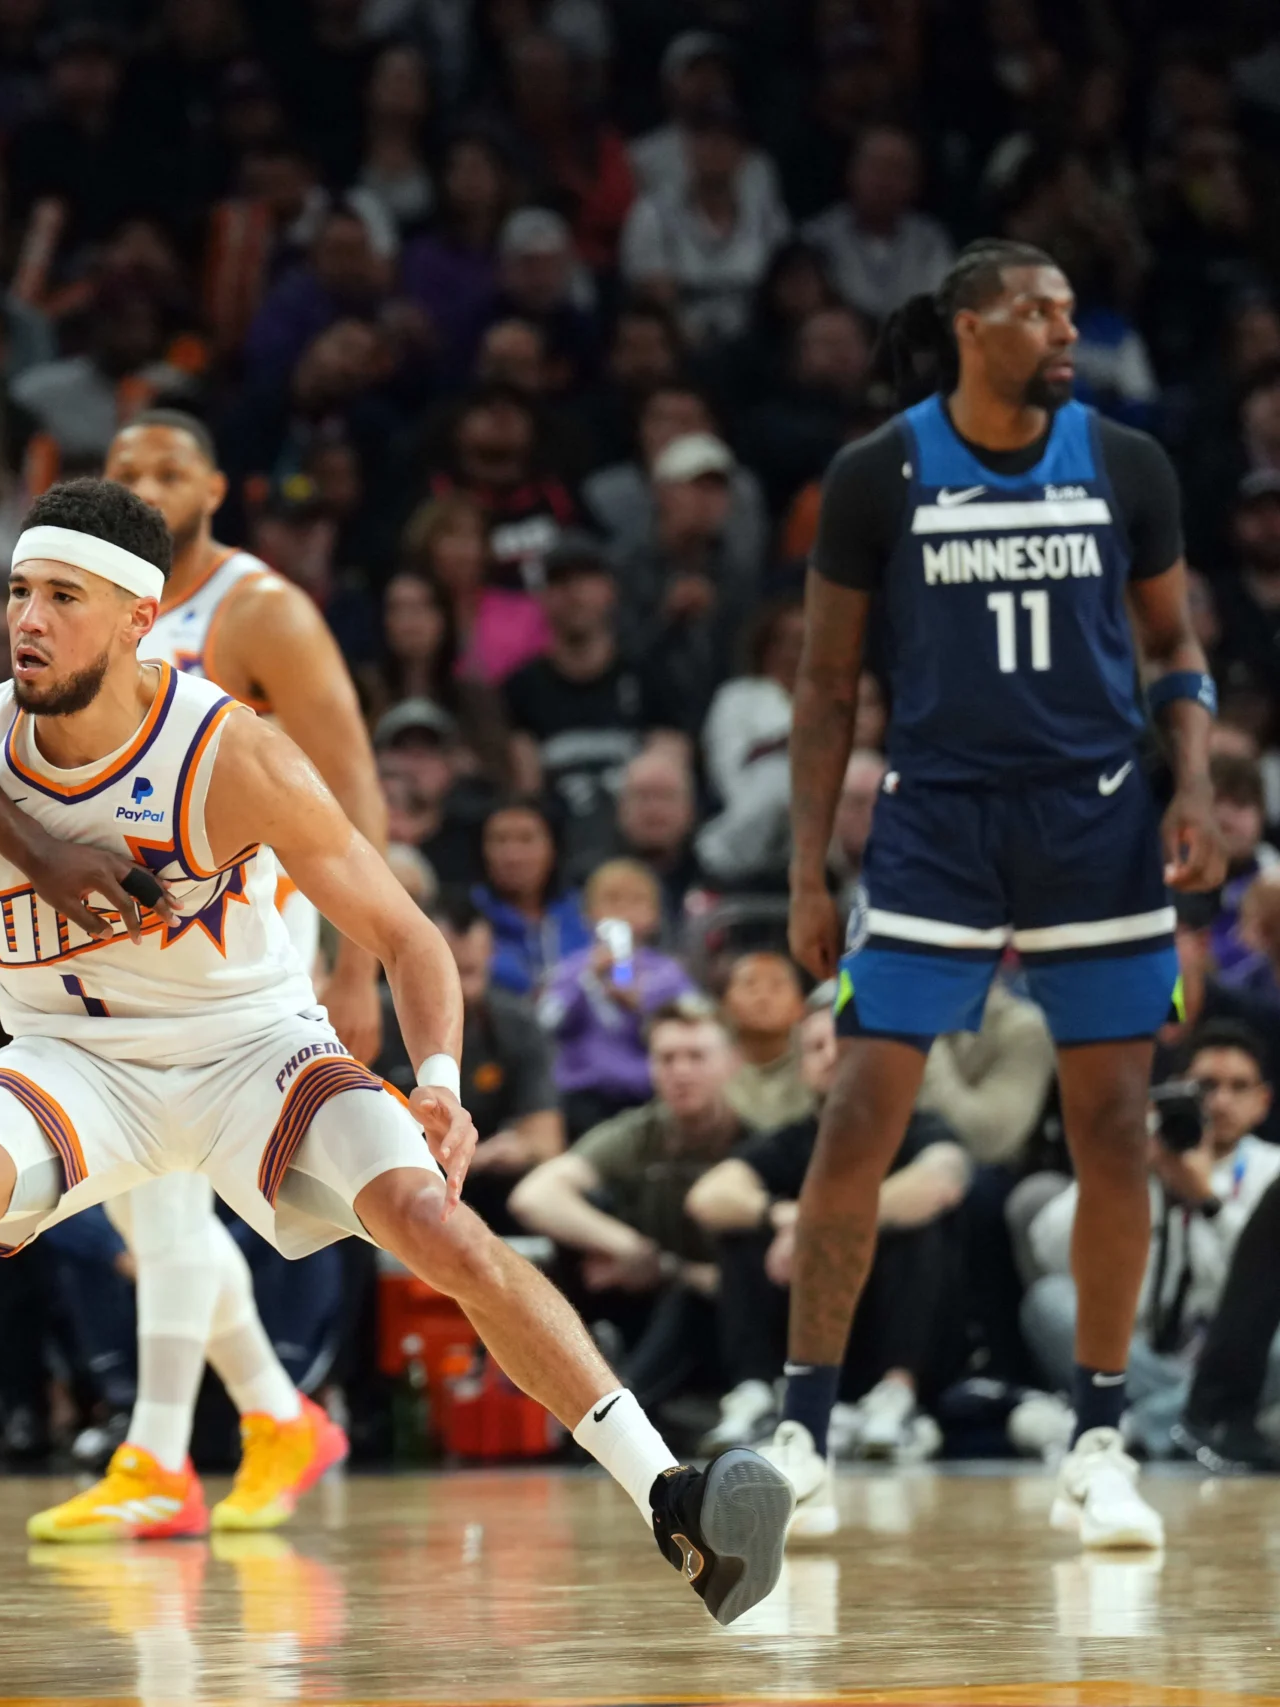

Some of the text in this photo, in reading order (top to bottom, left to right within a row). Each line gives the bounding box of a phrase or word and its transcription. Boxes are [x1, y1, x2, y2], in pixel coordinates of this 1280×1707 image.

[922, 532, 1103, 585] MINNESOTA
[987, 589, 1052, 673] 11
[116, 806, 165, 822] PayPal
[275, 1042, 348, 1094] PHOENI
